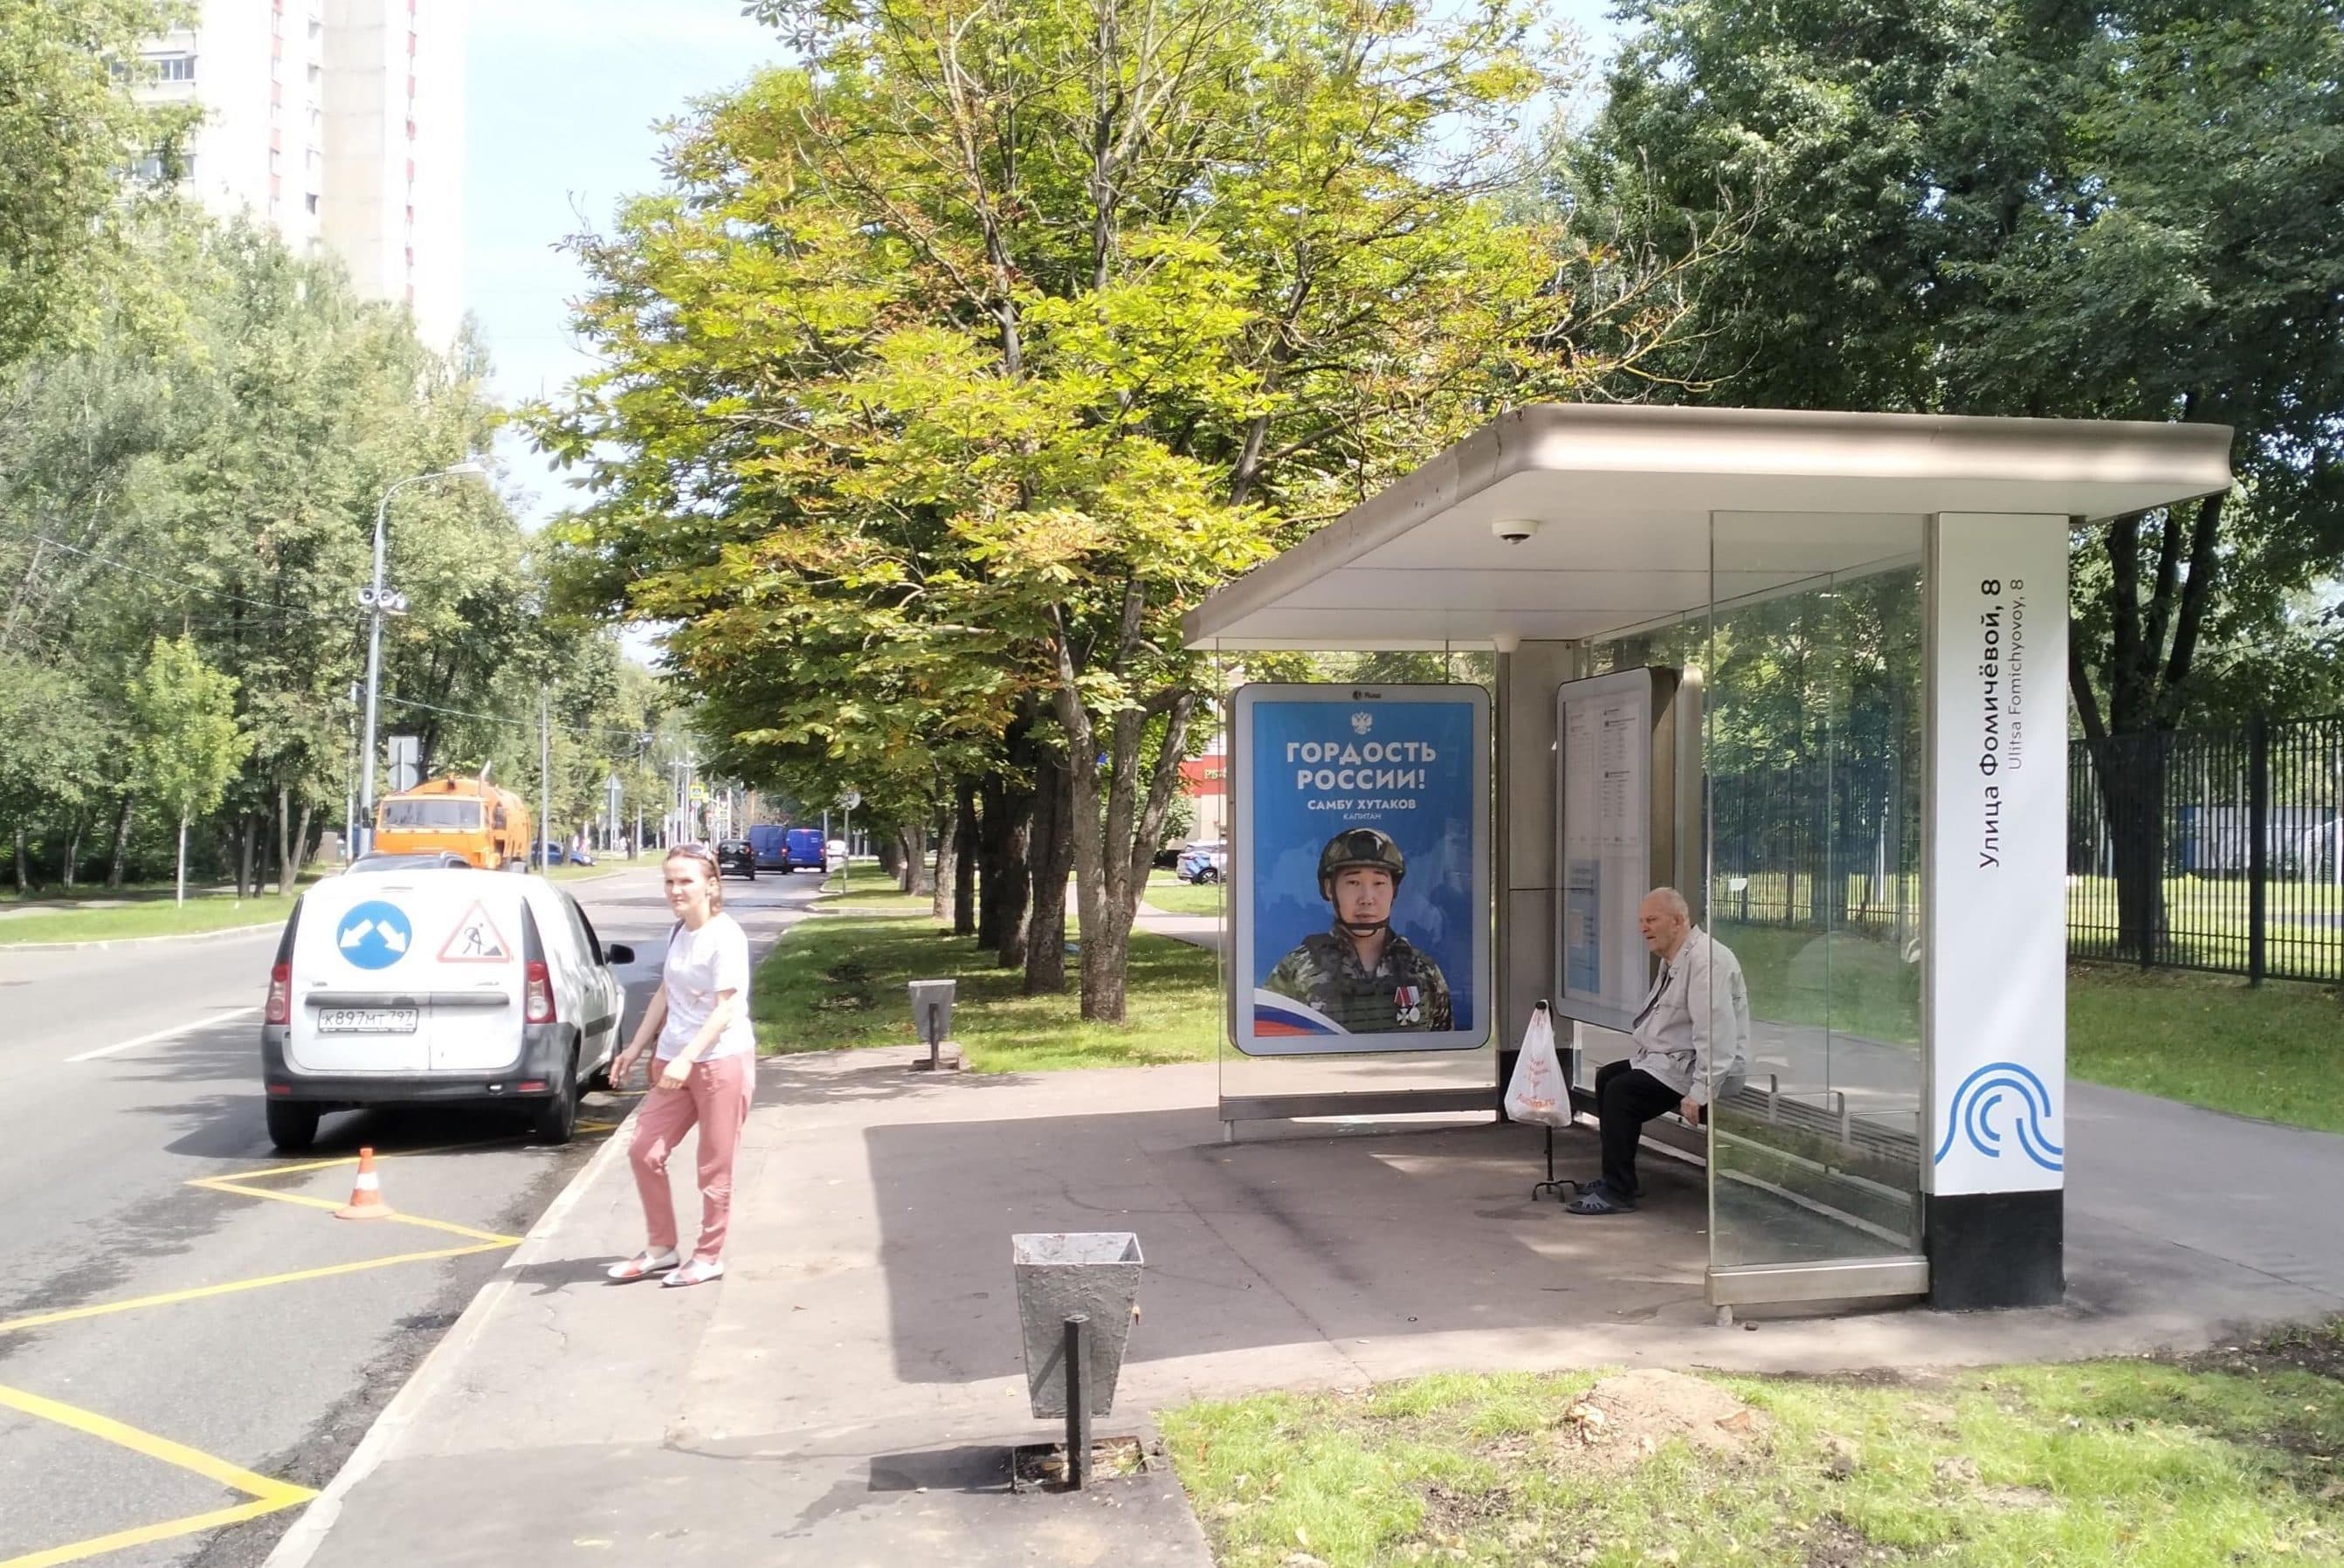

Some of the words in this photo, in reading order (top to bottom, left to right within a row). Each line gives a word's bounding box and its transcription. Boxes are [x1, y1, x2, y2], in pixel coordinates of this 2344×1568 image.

[1981, 578, 2002, 595] 8
[2010, 578, 2024, 590] 8
[2009, 596, 2025, 715] Fomichyovoy,
[1979, 605, 2004, 776] Фомичёвой,
[1286, 741, 1437, 766] ГОРДОСТЬ
[2009, 720, 2023, 770] Ulitsa
[1297, 768, 1426, 790] РОССИИ!
[1307, 799, 1354, 810] САМБУ
[1357, 798, 1417, 810] ХУТАКОВ
[1343, 812, 1382, 821] КАПИТАН
[1979, 786, 2002, 869] Улица
